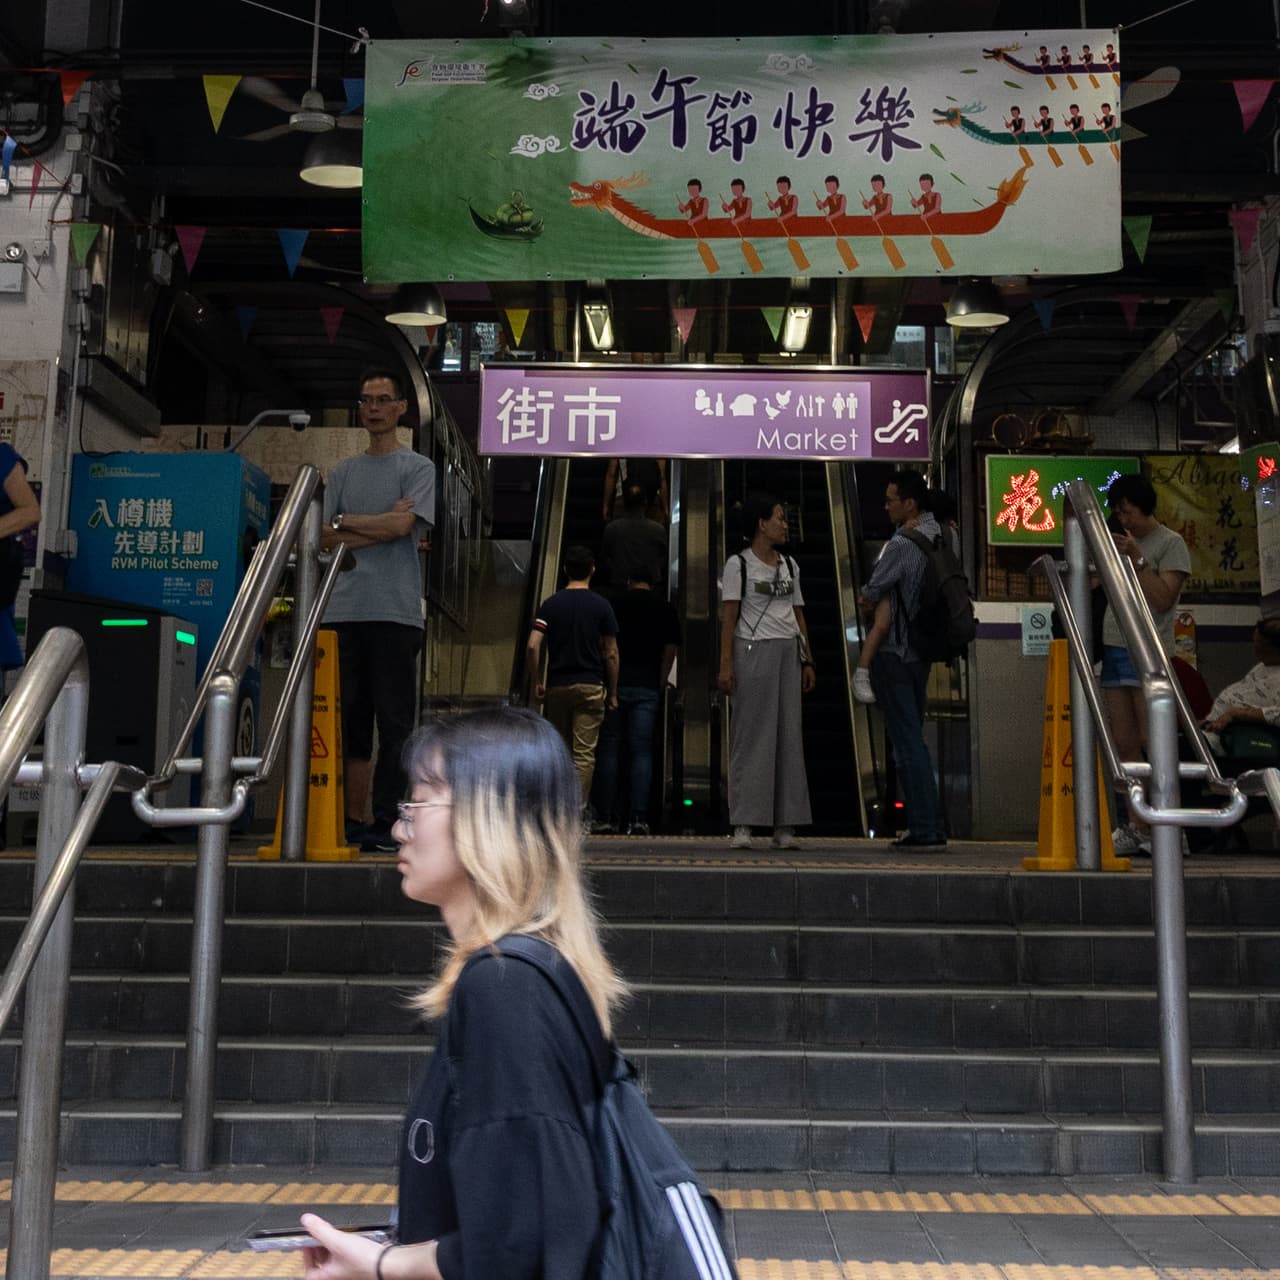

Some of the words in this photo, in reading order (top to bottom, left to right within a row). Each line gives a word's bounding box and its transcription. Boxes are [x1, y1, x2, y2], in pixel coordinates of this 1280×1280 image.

[569, 67, 924, 163] 端午節快樂
[496, 386, 622, 446] 街市
[756, 427, 859, 451] Market
[87, 498, 174, 528] 入樽機
[995, 468, 1056, 533] 花
[114, 530, 205, 555] 先導計劃
[111, 558, 138, 569] RVM
[140, 558, 170, 570] Pilot
[170, 558, 219, 570] Scheme
